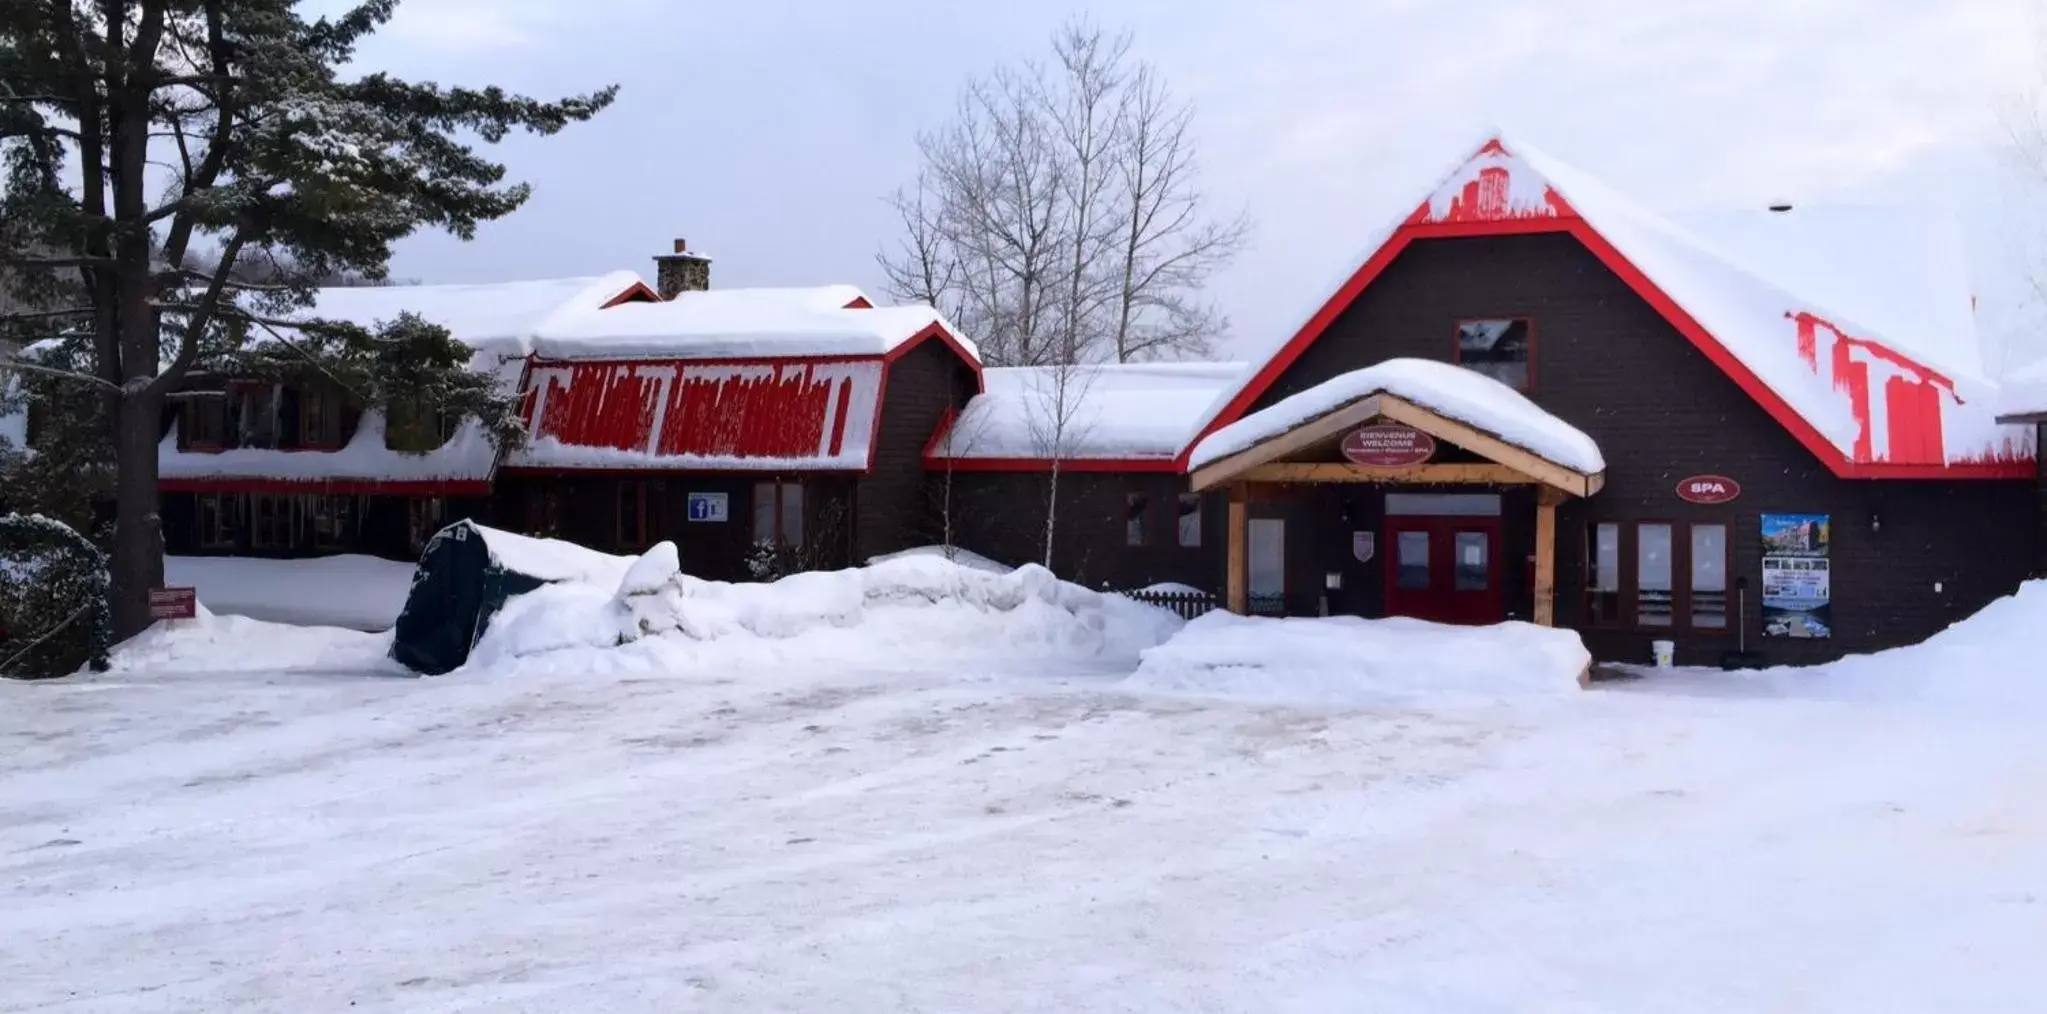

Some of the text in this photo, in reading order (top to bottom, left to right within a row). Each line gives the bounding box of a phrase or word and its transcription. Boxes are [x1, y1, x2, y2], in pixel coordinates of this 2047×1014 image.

[1360, 431, 1416, 439] BIENVENUE
[1362, 440, 1413, 448] WELCOME
[1691, 482, 1725, 493] SPA
